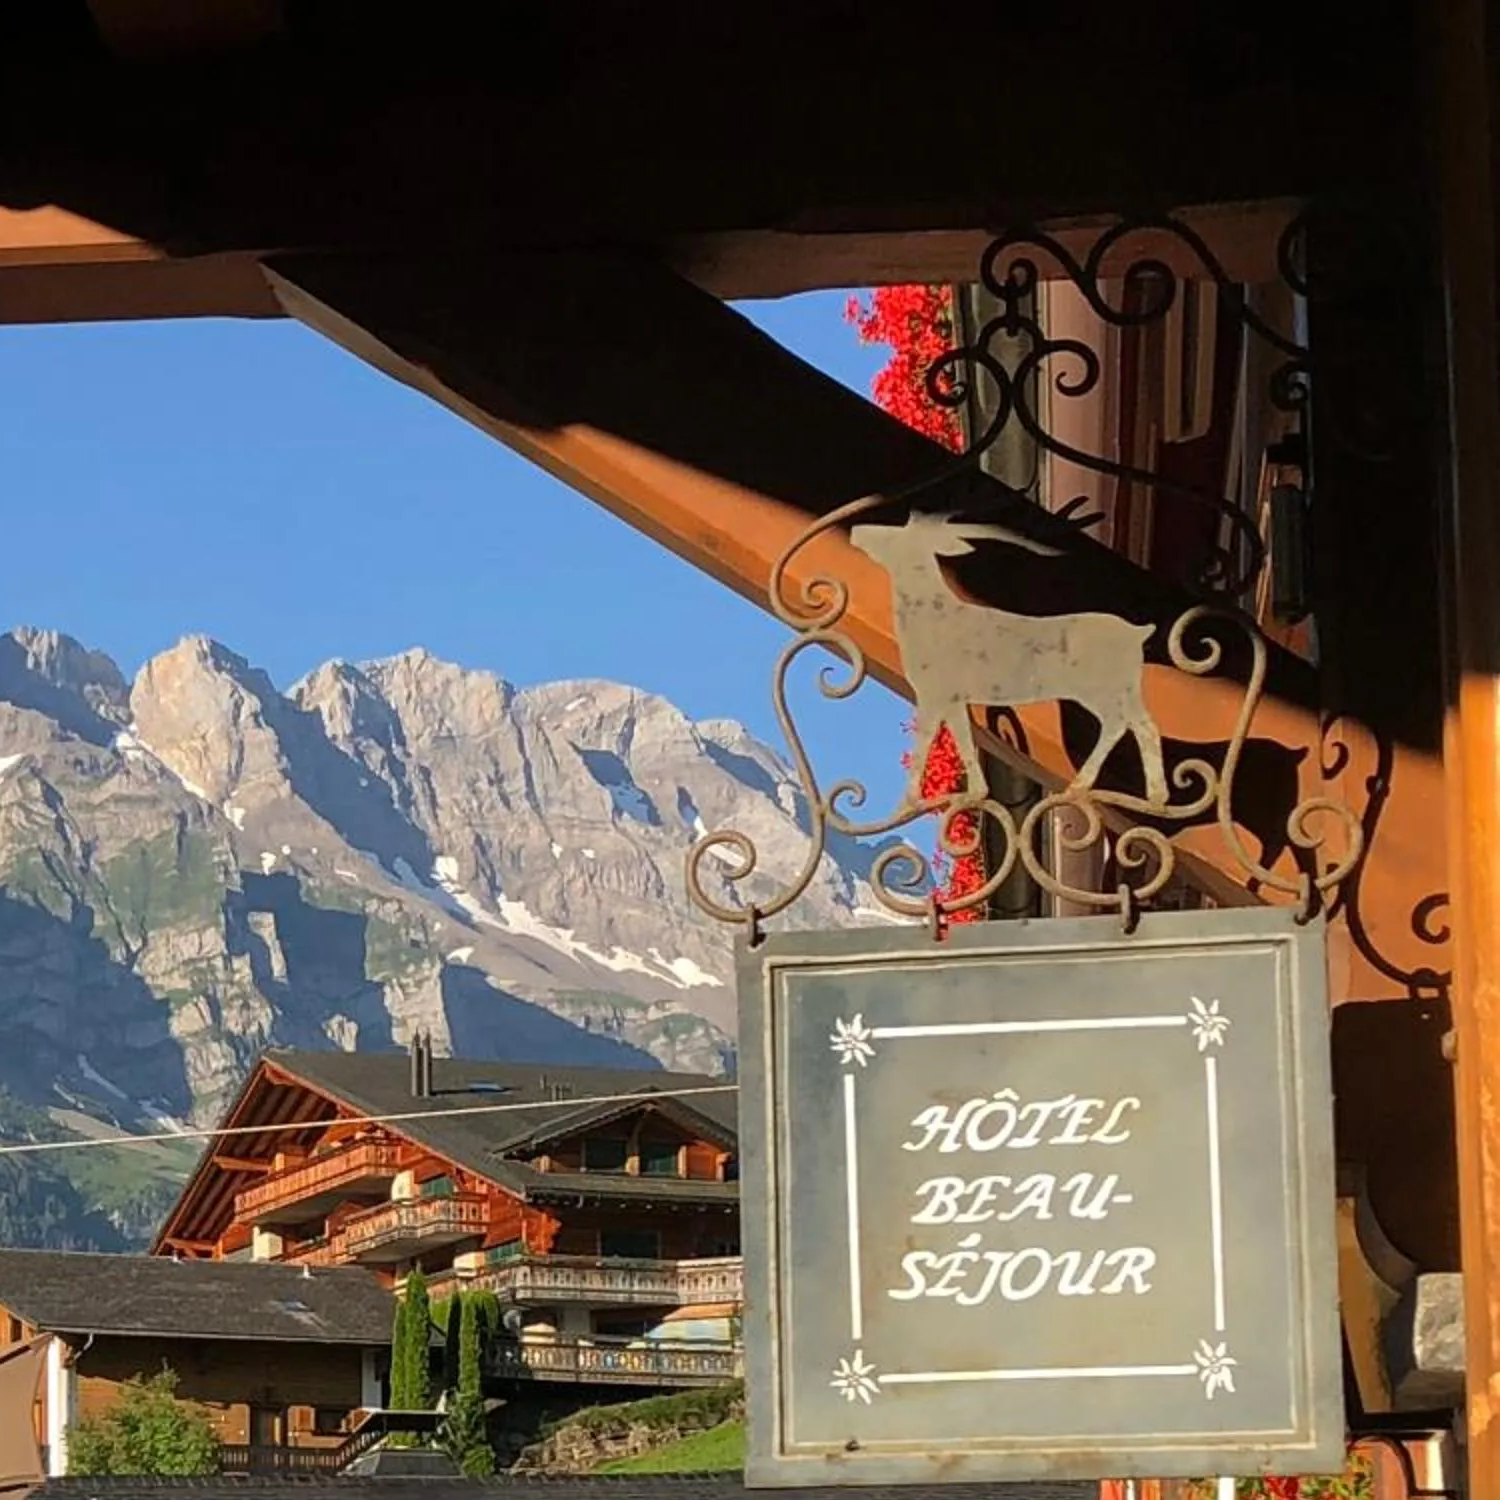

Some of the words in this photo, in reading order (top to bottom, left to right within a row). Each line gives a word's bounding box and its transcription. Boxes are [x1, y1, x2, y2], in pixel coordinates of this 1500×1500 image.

[903, 1088, 1140, 1152] HÔTEL
[911, 1172, 1133, 1224] BEAU-
[889, 1233, 1156, 1304] SÉJOUR
